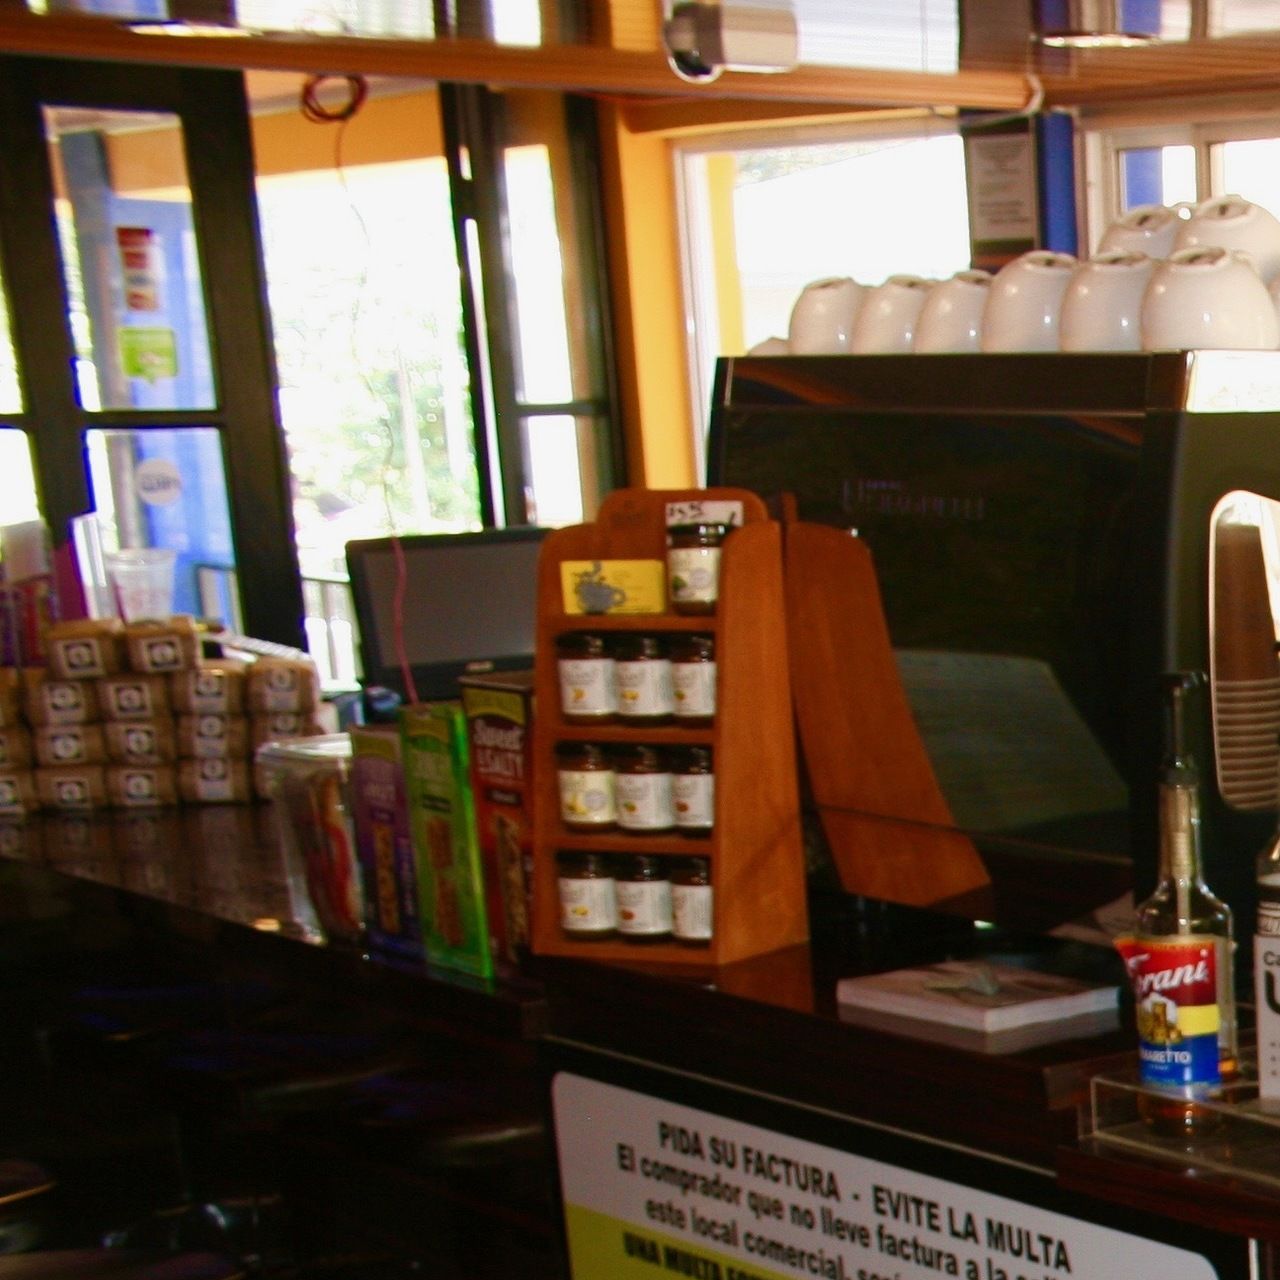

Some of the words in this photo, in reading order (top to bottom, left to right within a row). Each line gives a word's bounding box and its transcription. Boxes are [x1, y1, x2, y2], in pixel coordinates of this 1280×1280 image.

[616, 1142, 634, 1171] El
[639, 1157, 740, 1203] comprador
[746, 1190, 783, 1220] que
[788, 1203, 815, 1230] no
[819, 1206, 870, 1248] lleve
[875, 1223, 958, 1276] factura
[644, 1199, 685, 1229] este
[691, 1213, 737, 1246] local
[657, 1120, 704, 1159] PIDA
[708, 1135, 736, 1169] SU
[741, 1145, 840, 1201] FACTURA
[871, 1184, 940, 1233] EVITE
[947, 1206, 979, 1244] LA
[984, 1218, 1071, 1273] MULTA
